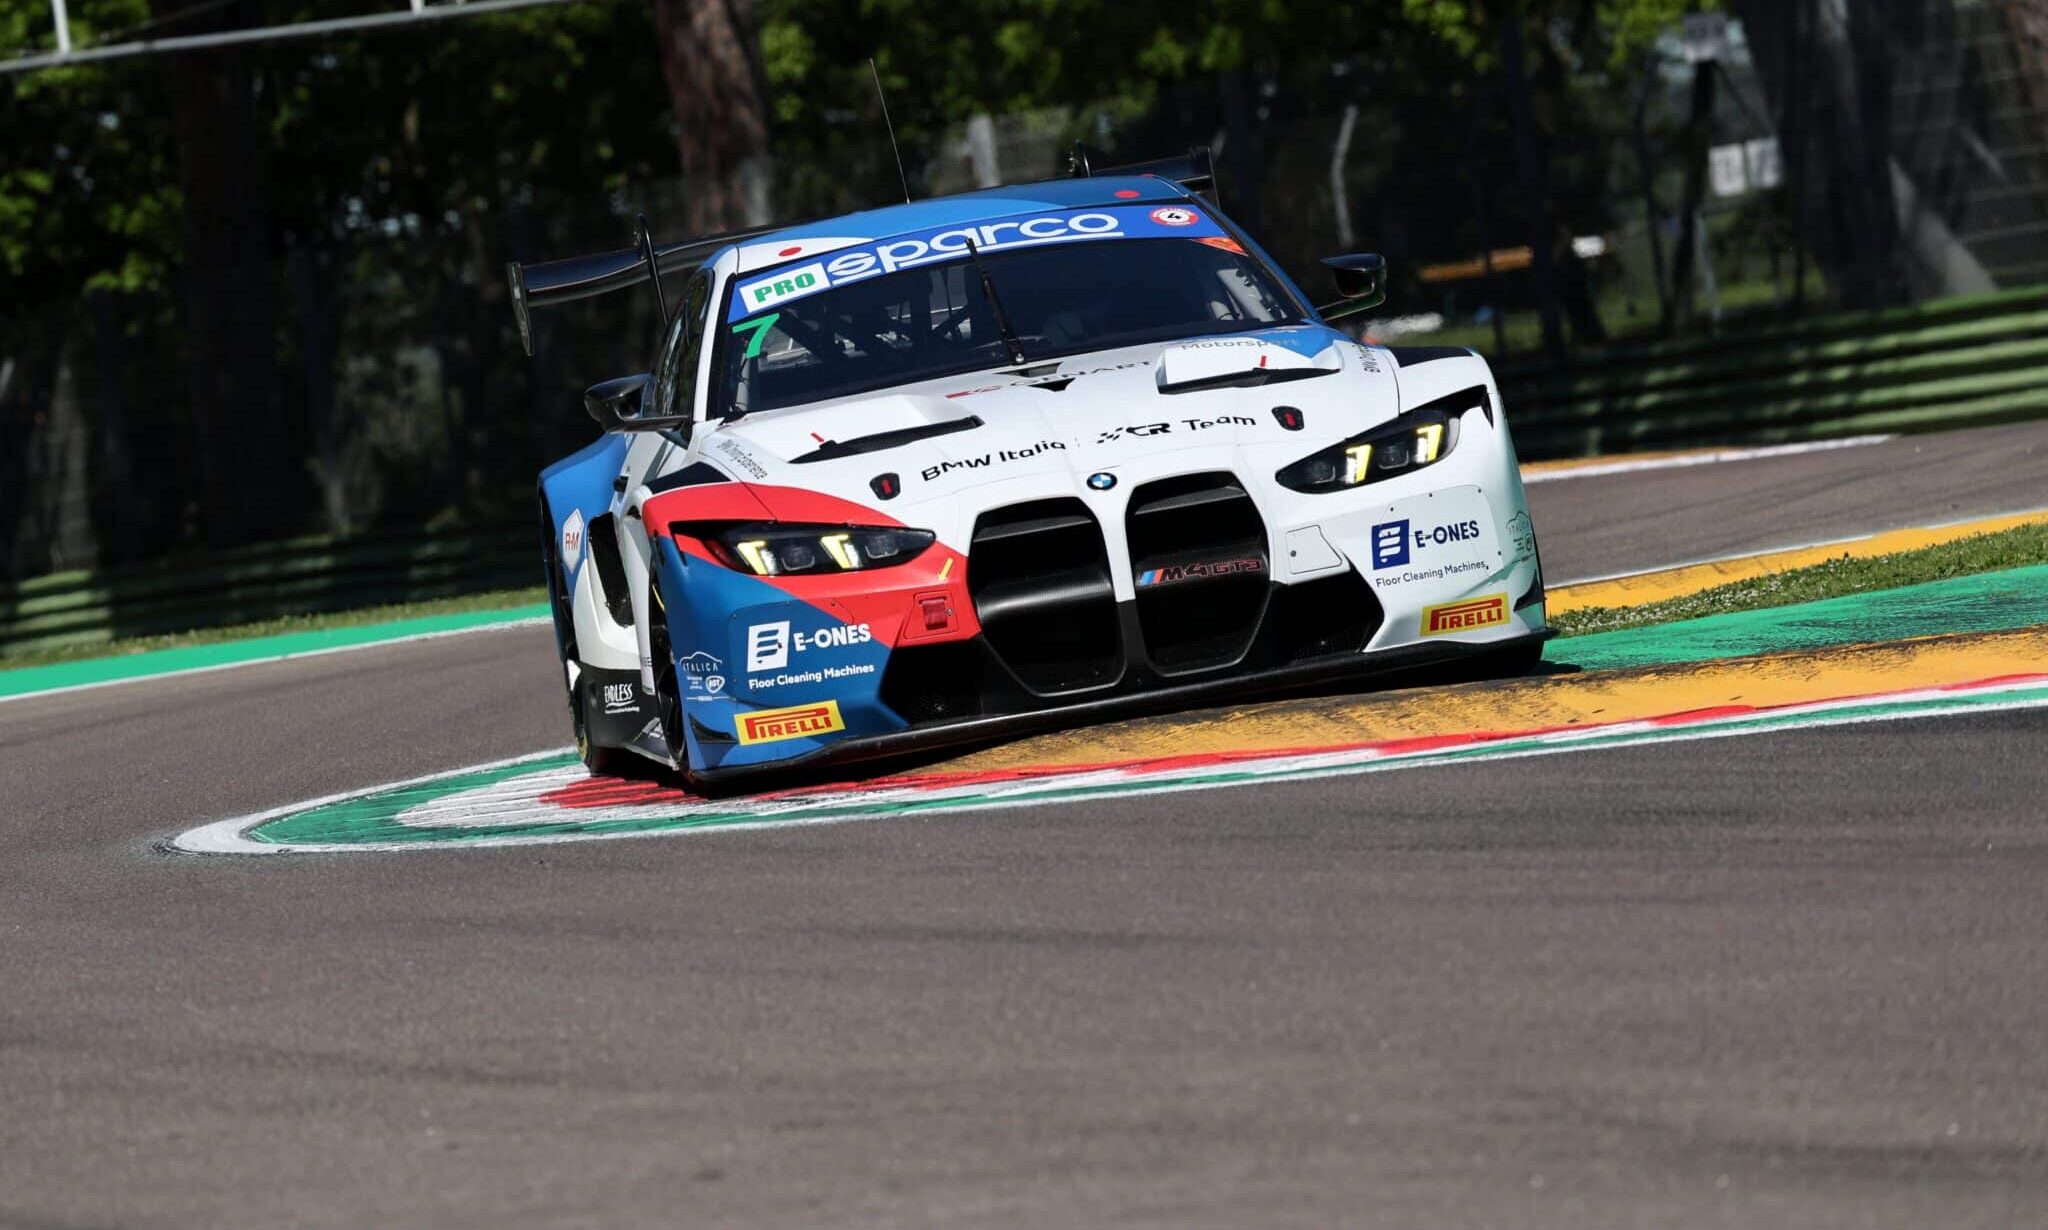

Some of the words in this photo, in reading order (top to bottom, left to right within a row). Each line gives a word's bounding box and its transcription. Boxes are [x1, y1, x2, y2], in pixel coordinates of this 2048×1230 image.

[827, 213, 1121, 279] sparco
[753, 272, 816, 303] PRO
[732, 312, 780, 359] 7
[1181, 414, 1257, 432] Team
[920, 454, 991, 482] BMW
[999, 438, 1066, 463] Italia
[1415, 519, 1480, 549] E-ONES
[1375, 576, 1401, 588] Floor
[1402, 568, 1444, 583] Cleaning
[1444, 560, 1486, 575] Machines
[1429, 598, 1503, 632] PIRELLI
[793, 623, 872, 652] E-ONES
[682, 662, 718, 672] ITALICA
[748, 677, 775, 690] Floor
[776, 670, 822, 686] Cleaning
[824, 663, 875, 679] Machines
[744, 707, 832, 739] PIRELLI
